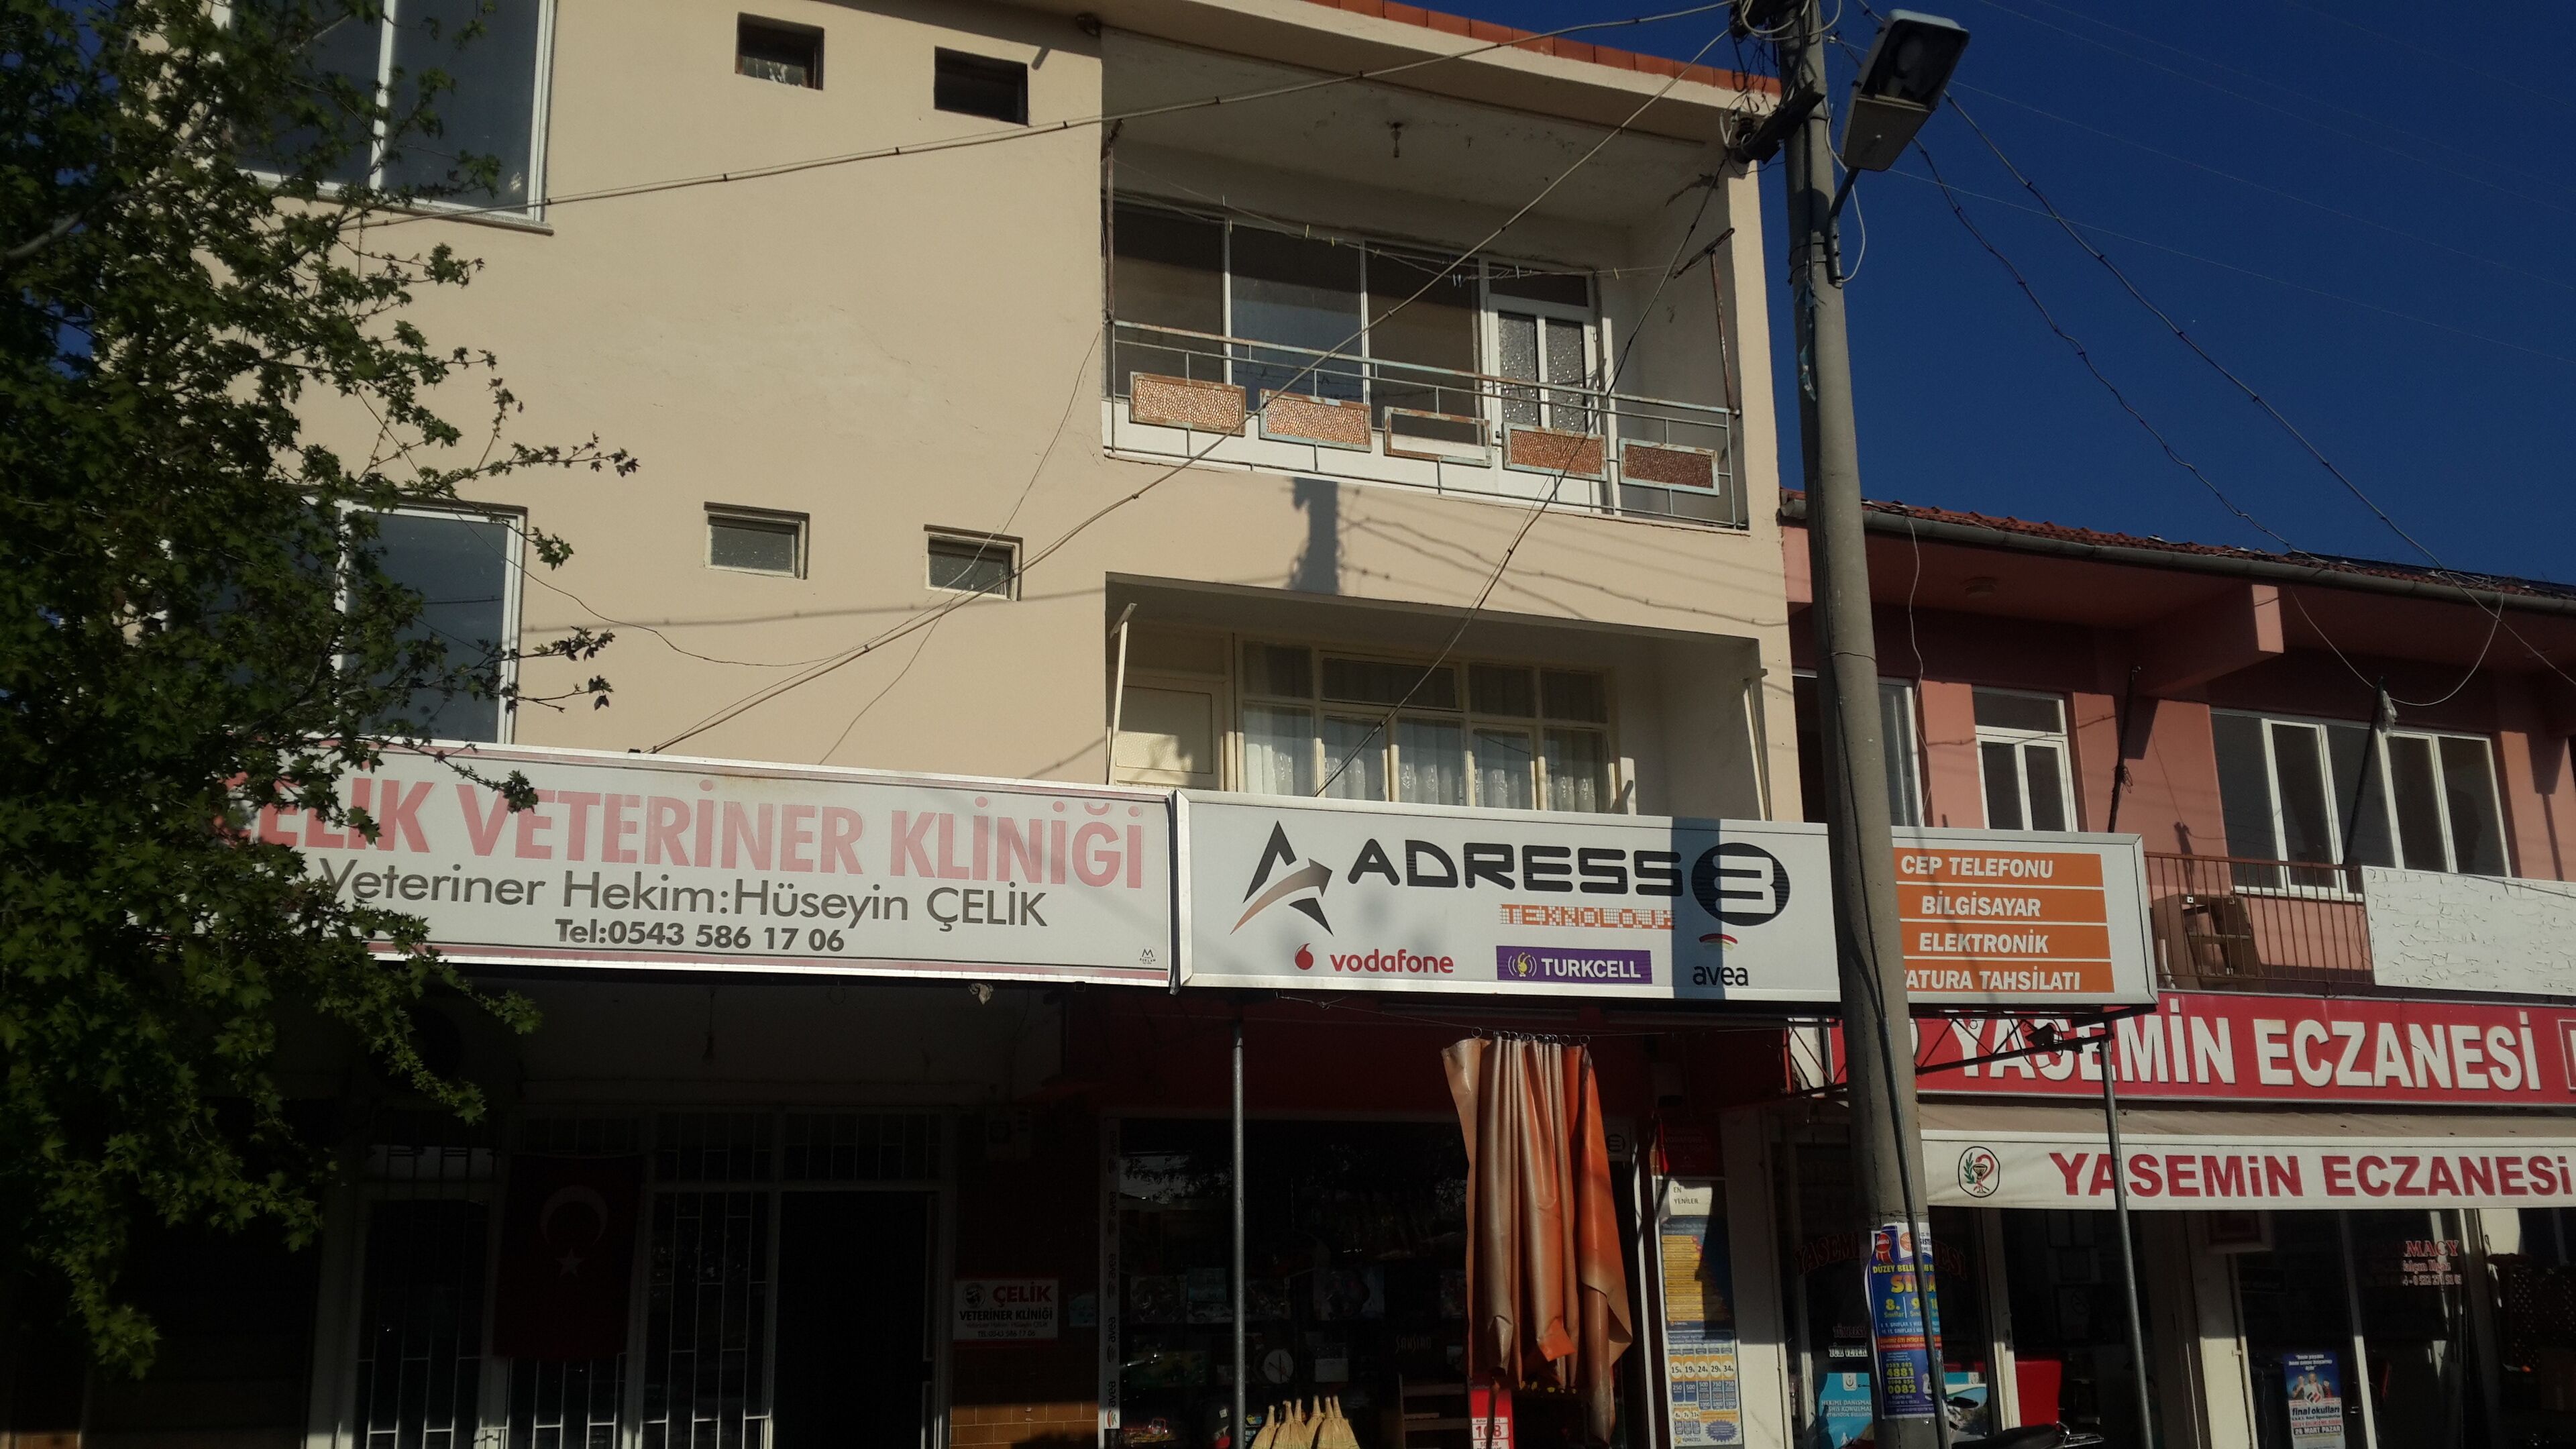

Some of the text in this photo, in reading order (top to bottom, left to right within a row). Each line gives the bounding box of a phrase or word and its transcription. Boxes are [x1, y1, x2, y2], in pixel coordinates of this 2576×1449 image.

[455, 779, 864, 875] VETERİNER
[890, 796, 1144, 889] KLİNİĞİ
[1348, 838, 1684, 897] ADRESS
[1901, 855, 2053, 878] CEP TELEFONU
[319, 858, 546, 906] Veteriner
[926, 881, 1048, 932] ÇELİK
[1921, 890, 2041, 917] BİLGİSAYAR
[554, 918, 845, 952] Tel:0543 586 17 06
[1919, 928, 2049, 953] ELEKTRONİK
[1329, 948, 1454, 974] vodafone
[1540, 957, 1642, 979] TURKCELL
[1692, 965, 1749, 987] avea
[1905, 965, 2080, 990] ATURA TAHSİLATI
[2253, 1011, 2541, 1091] ECZANESİ
[993, 1281, 1052, 1307] ÇELİK
[959, 1308, 1012, 1321] VETERİNER
[1108, 1316, 1117, 1342] avea
[1108, 1381, 1117, 1407] avea
[2292, 1407, 2310, 1416] final
